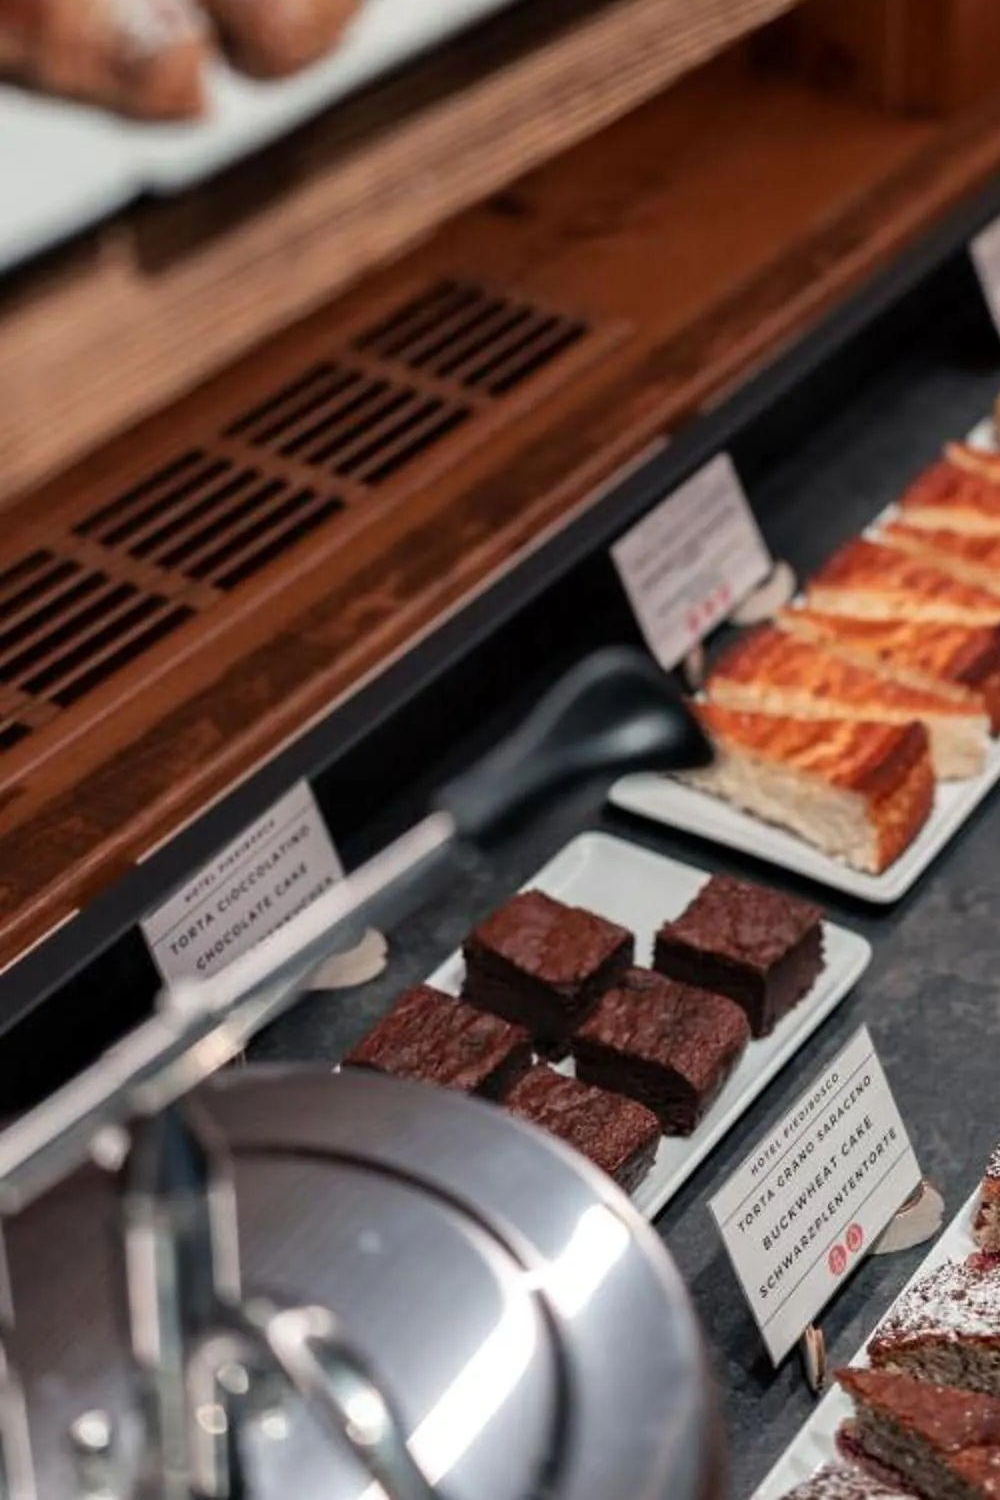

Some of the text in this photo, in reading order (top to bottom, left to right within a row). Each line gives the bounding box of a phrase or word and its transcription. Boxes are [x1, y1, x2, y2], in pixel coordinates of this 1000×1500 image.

[170, 913, 214, 955] TORTA
[218, 825, 309, 912] CIOCCOLATINO
[196, 896, 272, 970] CHOCOLATE
[275, 863, 307, 896] CAKE
[738, 1076, 870, 1233] TORTA GRANO SARACENO
[751, 1139, 781, 1176] HOTEL
[760, 1128, 896, 1298] SCHWARZPLENTENTORTE
[763, 1115, 872, 1250] BUCKWHEAT CAKE
